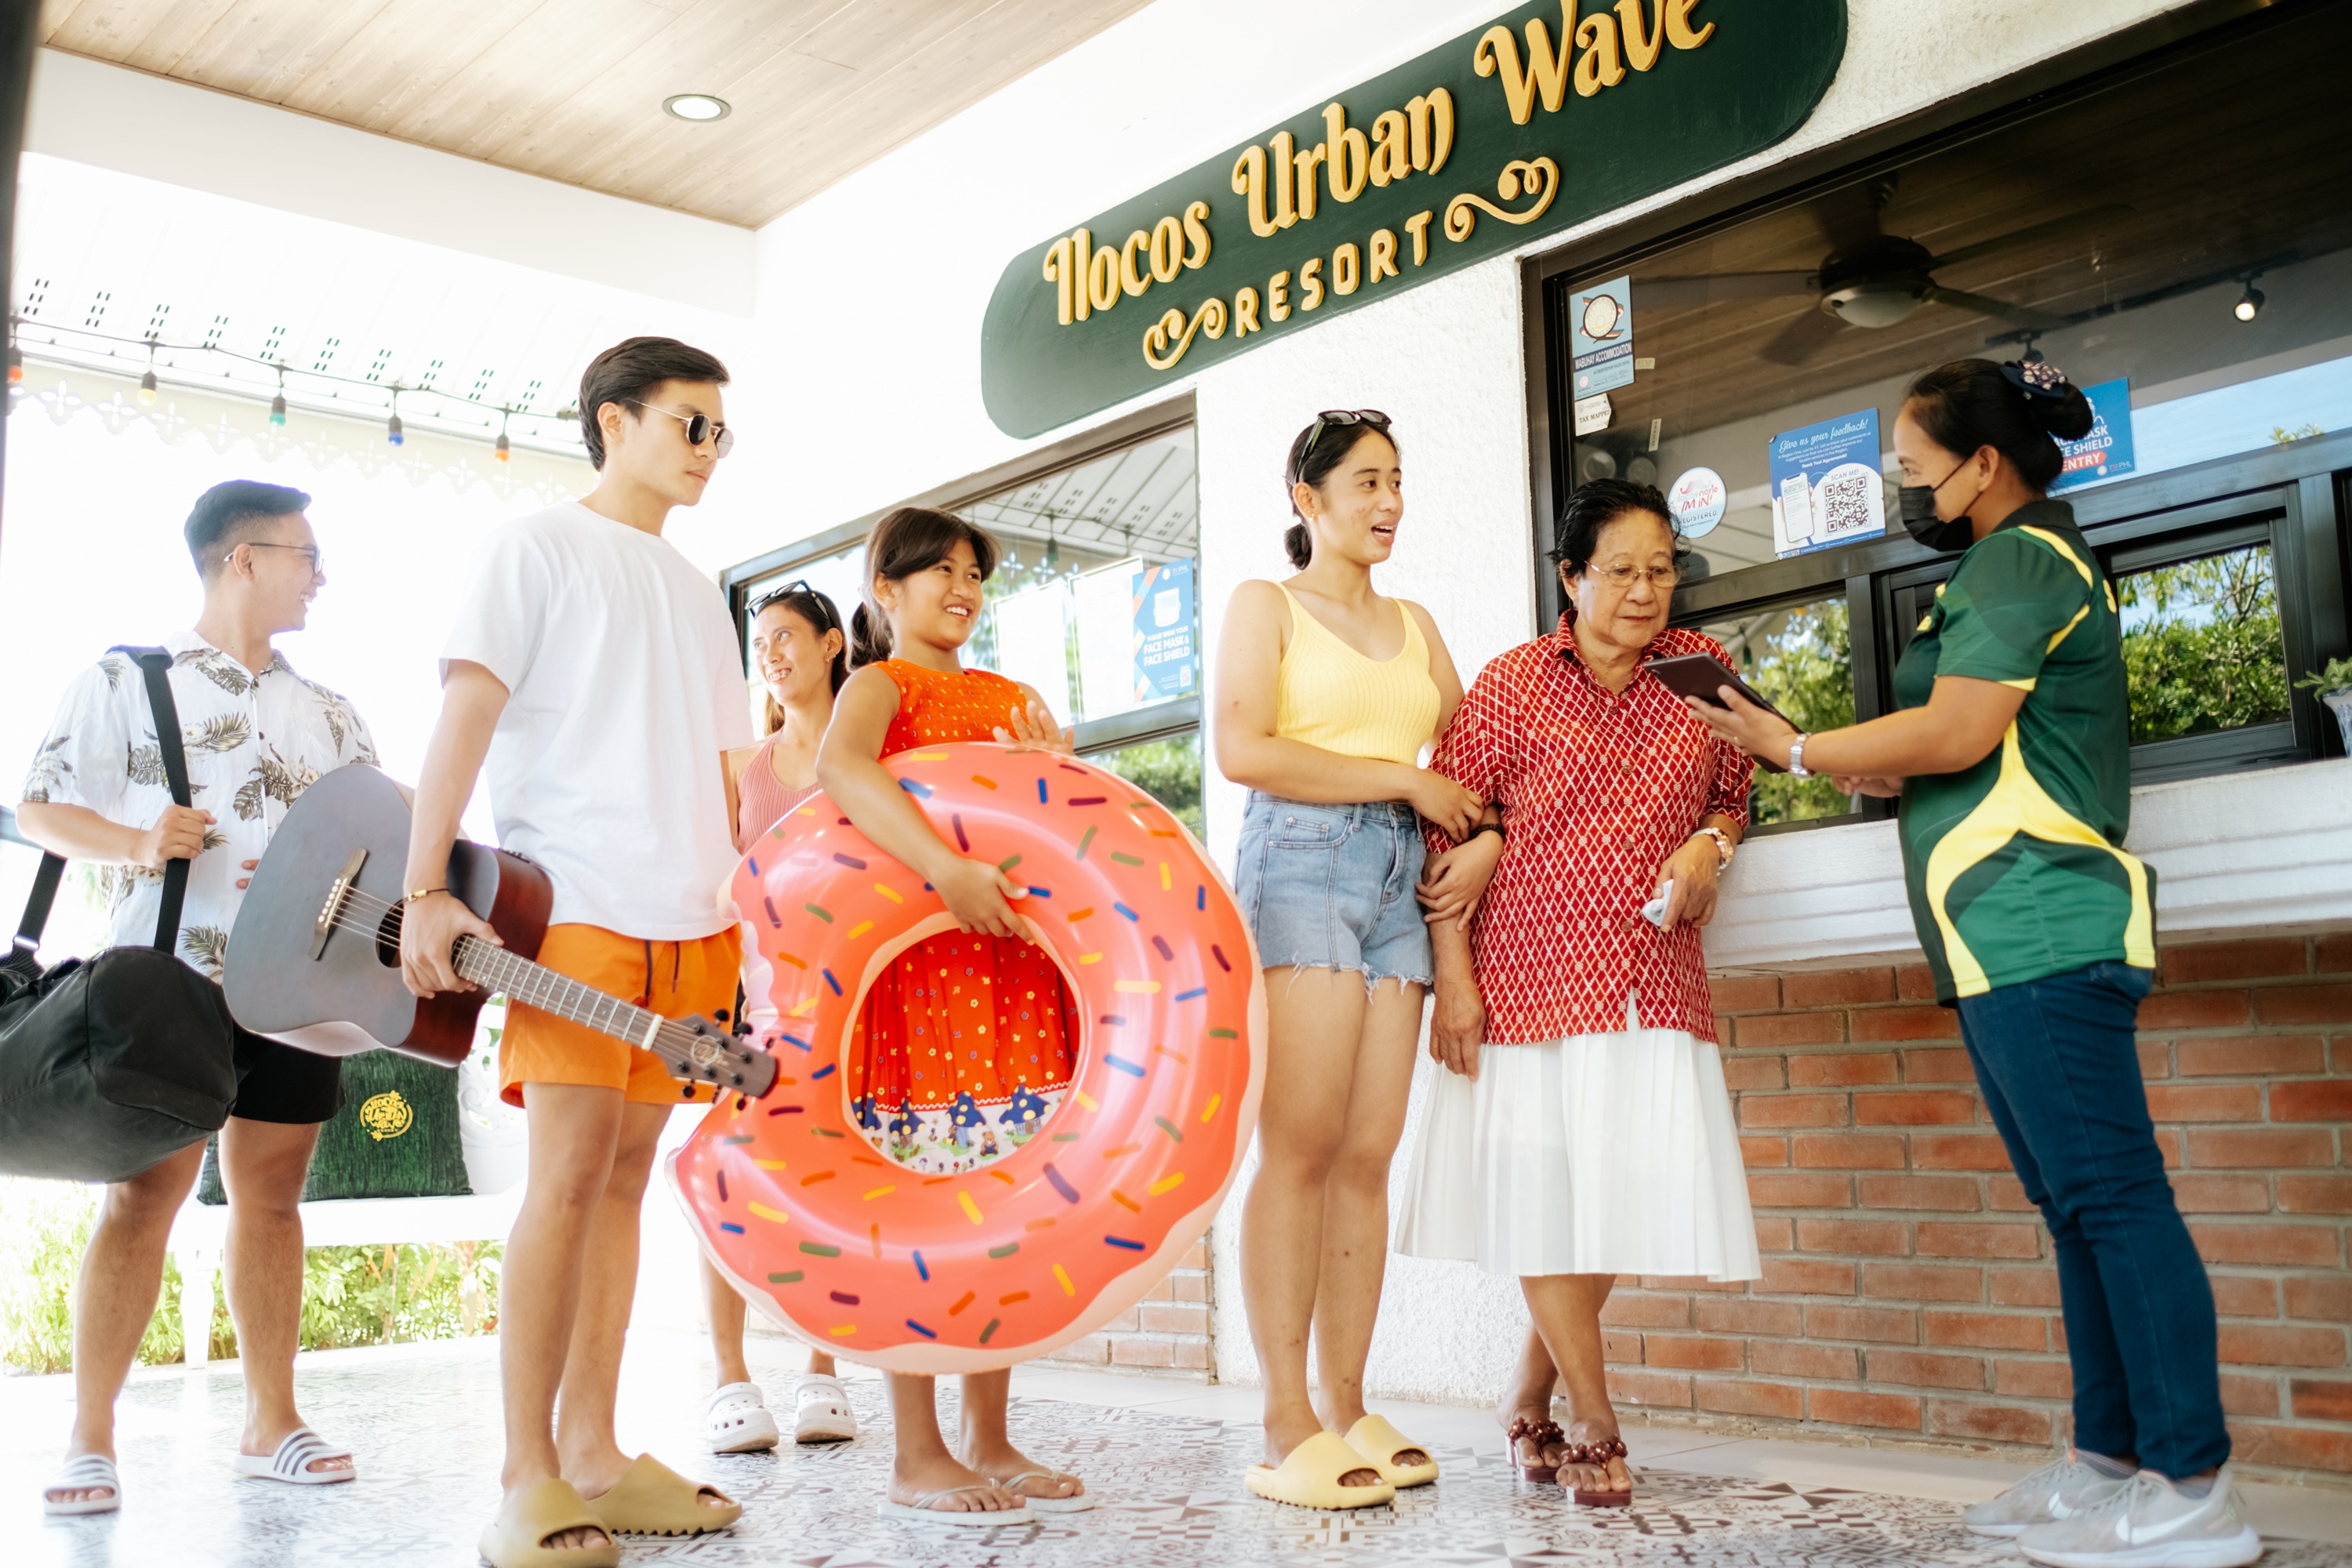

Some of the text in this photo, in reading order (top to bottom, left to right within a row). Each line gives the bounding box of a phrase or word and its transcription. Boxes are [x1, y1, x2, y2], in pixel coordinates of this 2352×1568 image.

[1043, 201, 1210, 325] Ilocos
[1232, 87, 1454, 238] Urban
[1235, 210, 1433, 339] RESORT
[1575, 343, 1632, 369] MABUHAY ACCOMMODATION
[1779, 419, 1868, 453] Give us your feedback!
[2074, 436, 2113, 454] SHIELD
[1831, 472, 1847, 481] SCAN
[1699, 485, 1719, 498] norte
[1679, 510, 1717, 524] REGISTERED
[1144, 641, 1162, 655] FACE
[1163, 635, 1184, 650] MASK
[1147, 633, 1162, 641] PLEASE
[1162, 629, 1175, 637] WEAR
[1144, 646, 1190, 667] FACE SHIELD
